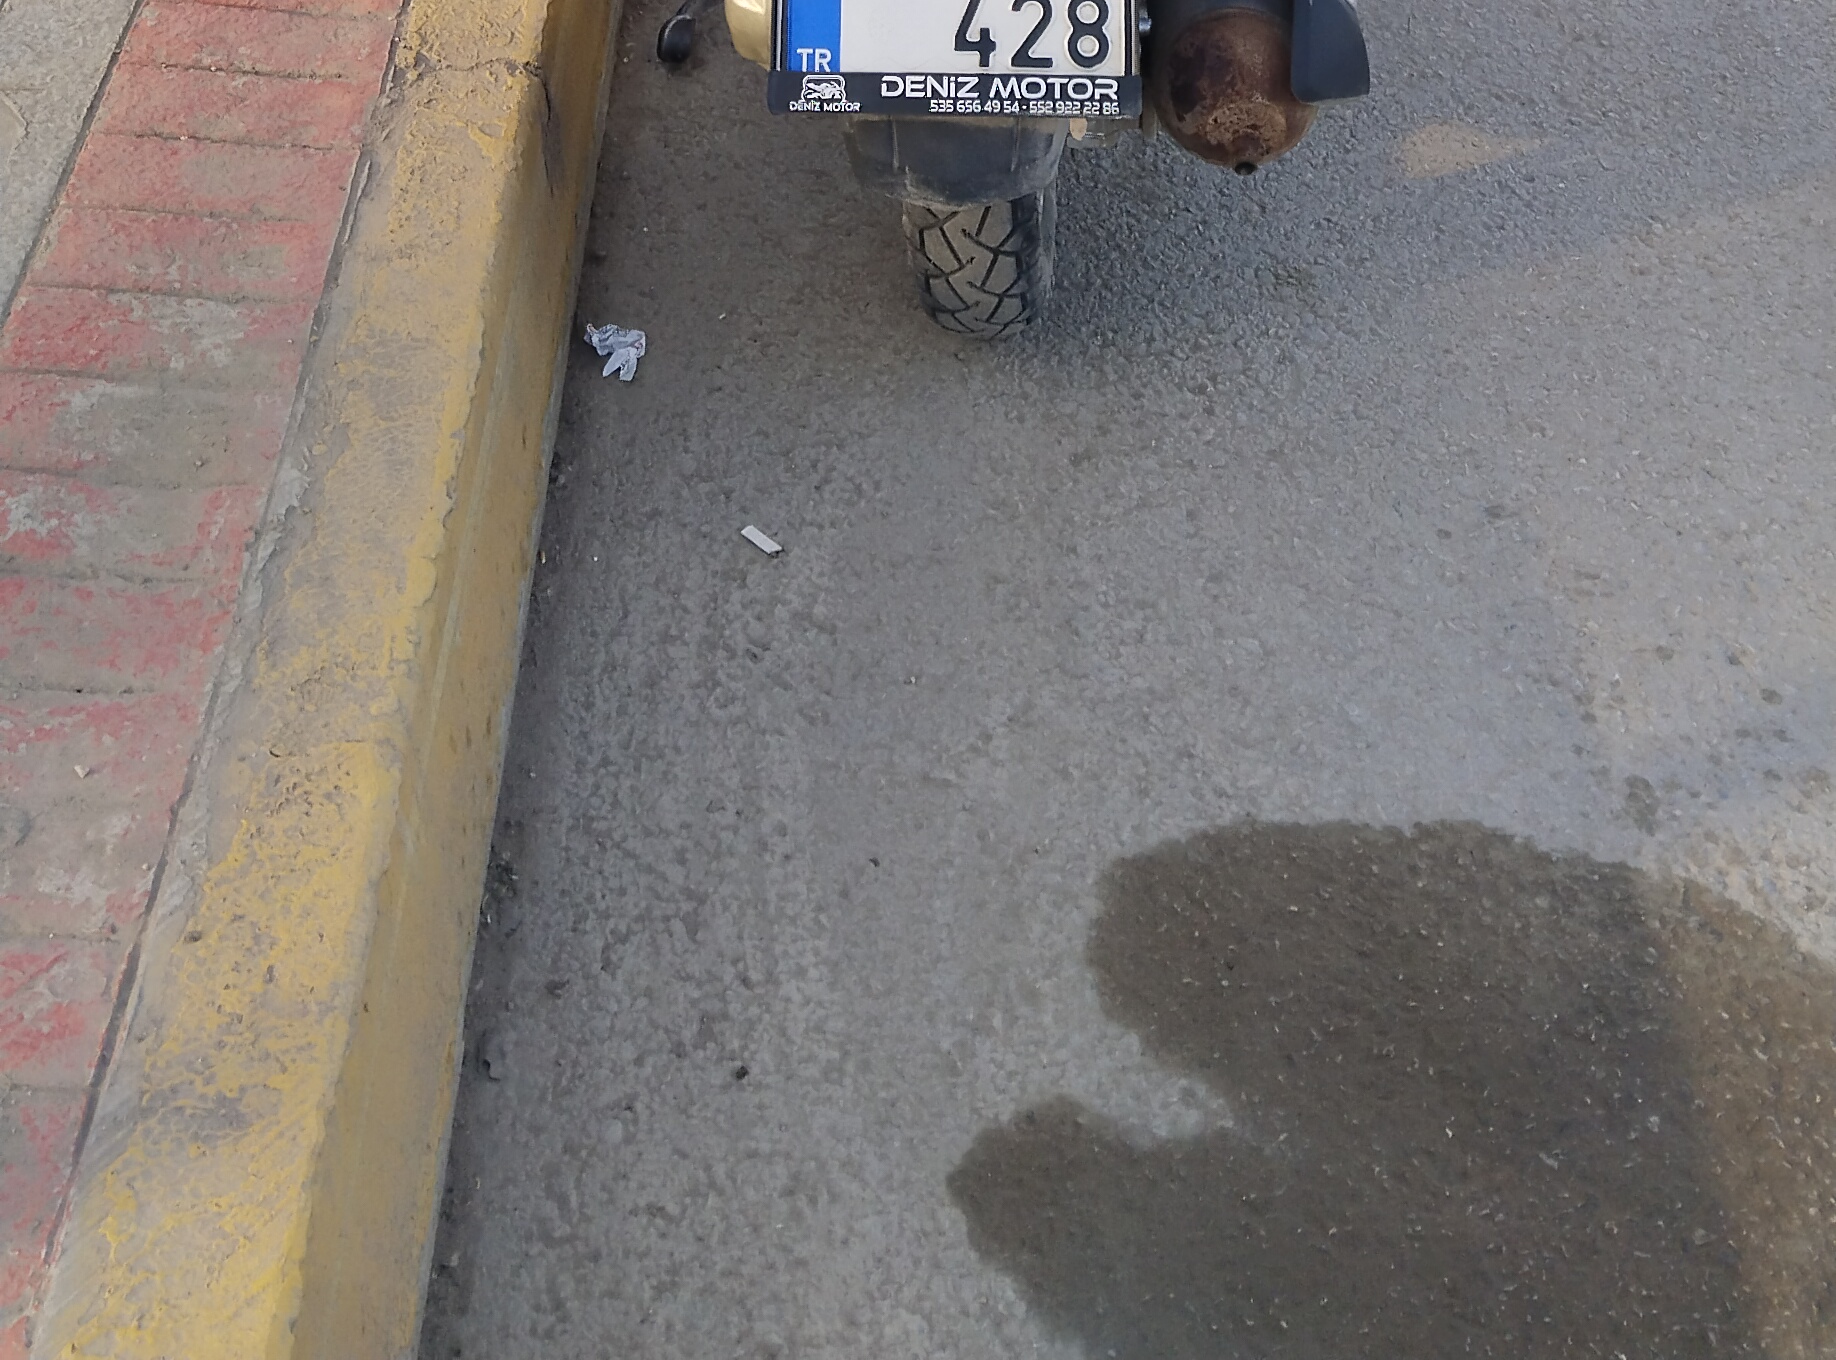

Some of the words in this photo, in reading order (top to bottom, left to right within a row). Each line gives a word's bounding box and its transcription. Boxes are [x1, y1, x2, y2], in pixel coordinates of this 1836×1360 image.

[796, 48, 832, 72] TR
[988, 77, 1119, 100] MOTOR
[823, 101, 861, 112] MOTOR
[1003, 100, 1020, 113] 54
[1083, 102, 1100, 115] 22
[1102, 102, 1120, 115] 86
